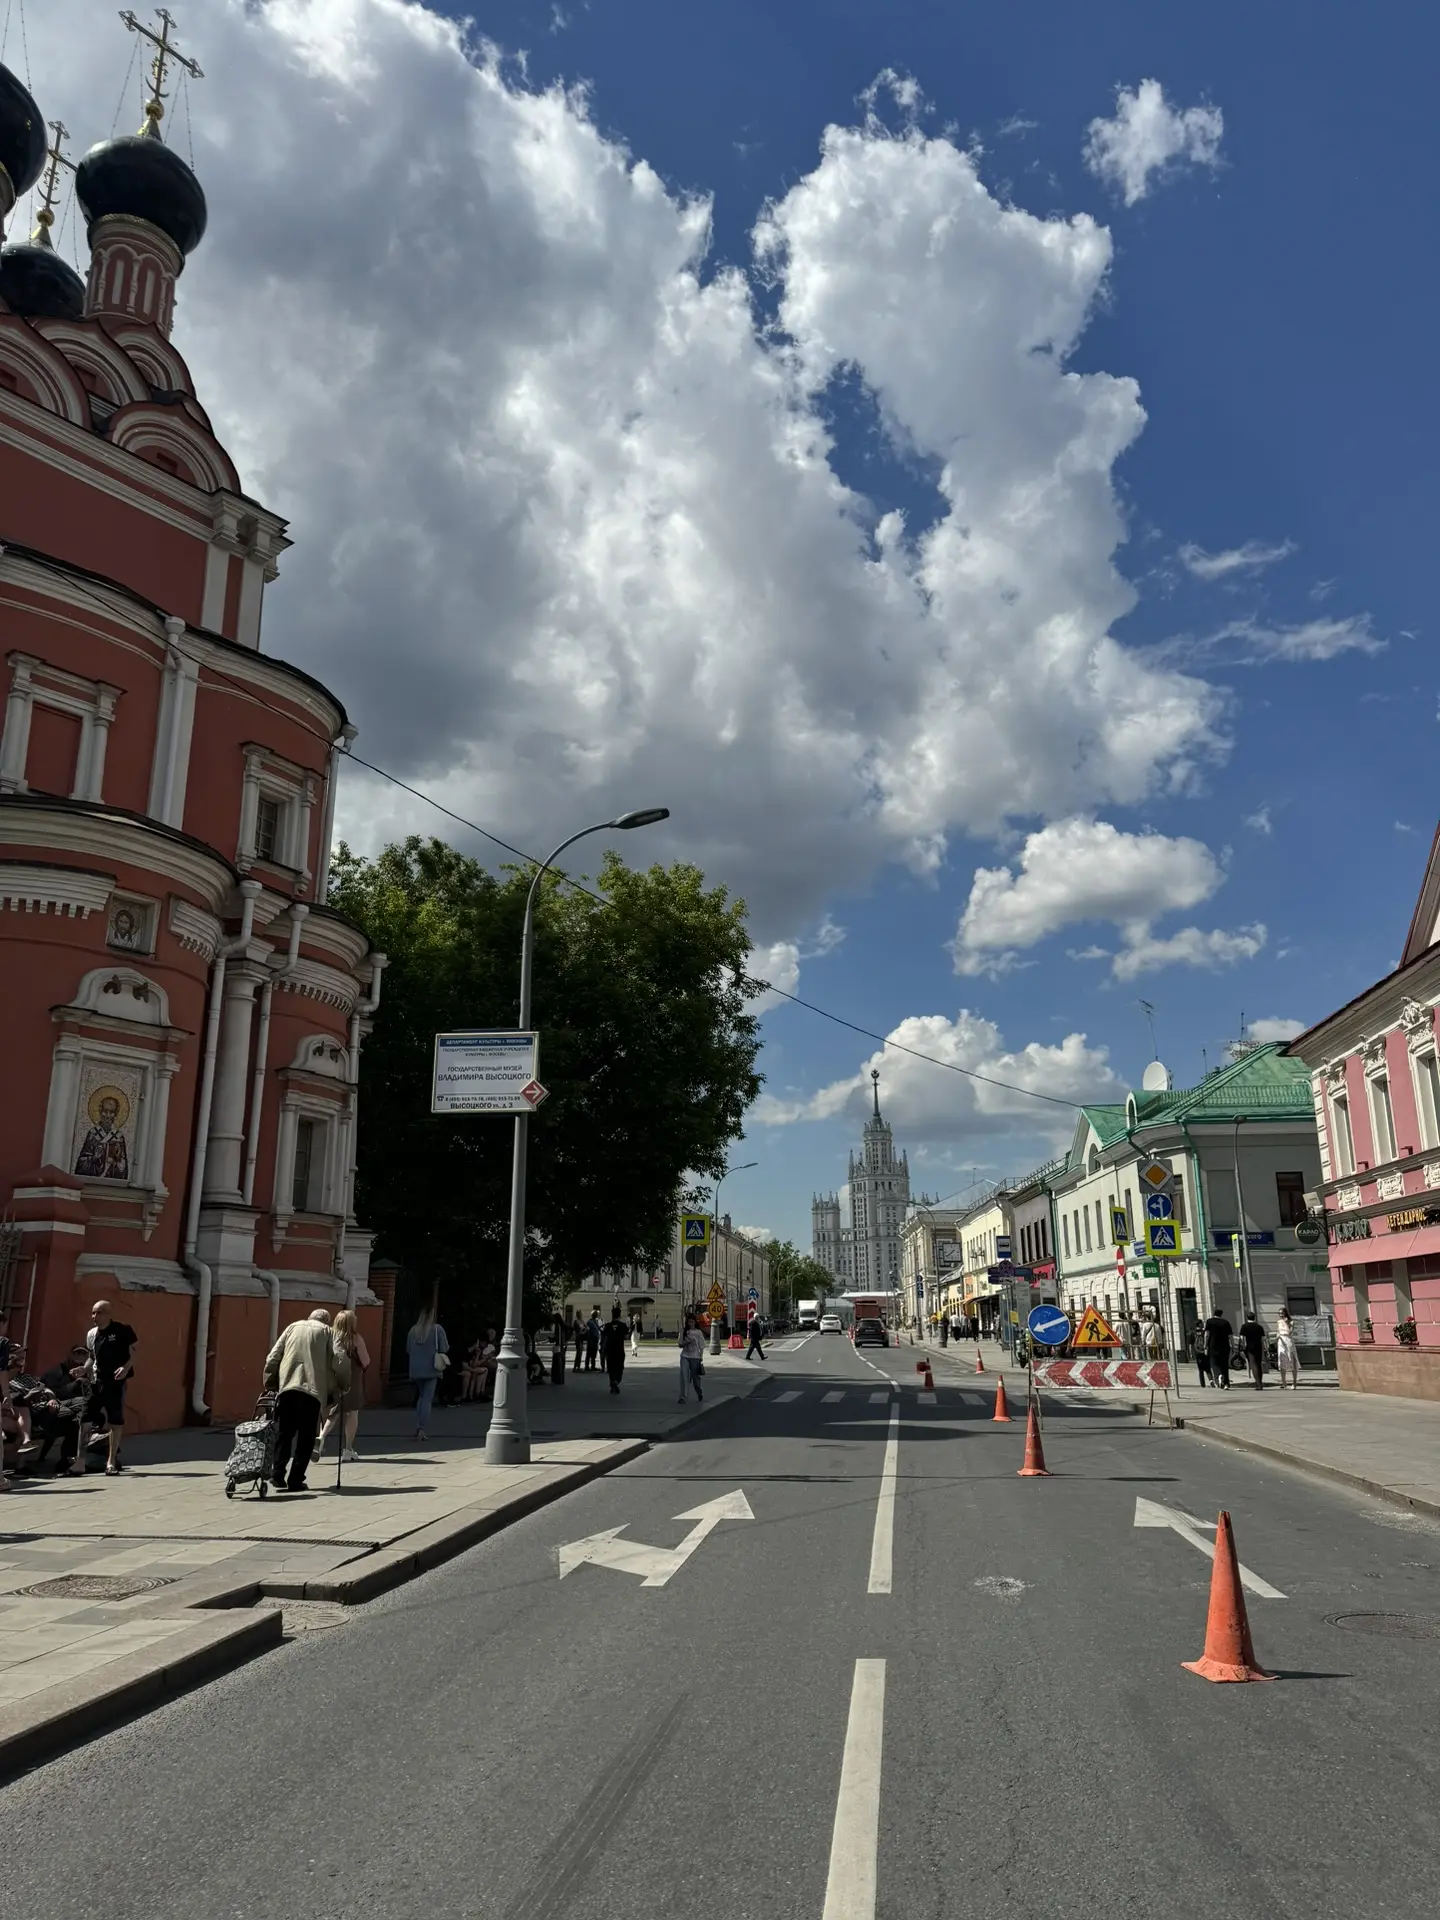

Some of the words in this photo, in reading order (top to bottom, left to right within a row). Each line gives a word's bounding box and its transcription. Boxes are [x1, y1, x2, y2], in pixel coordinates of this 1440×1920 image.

[437, 1073, 484, 1082] ВЛАДИМИРА
[485, 1072, 532, 1081] ВЫСОЦКОГО
[711, 1305, 722, 1313] 40
